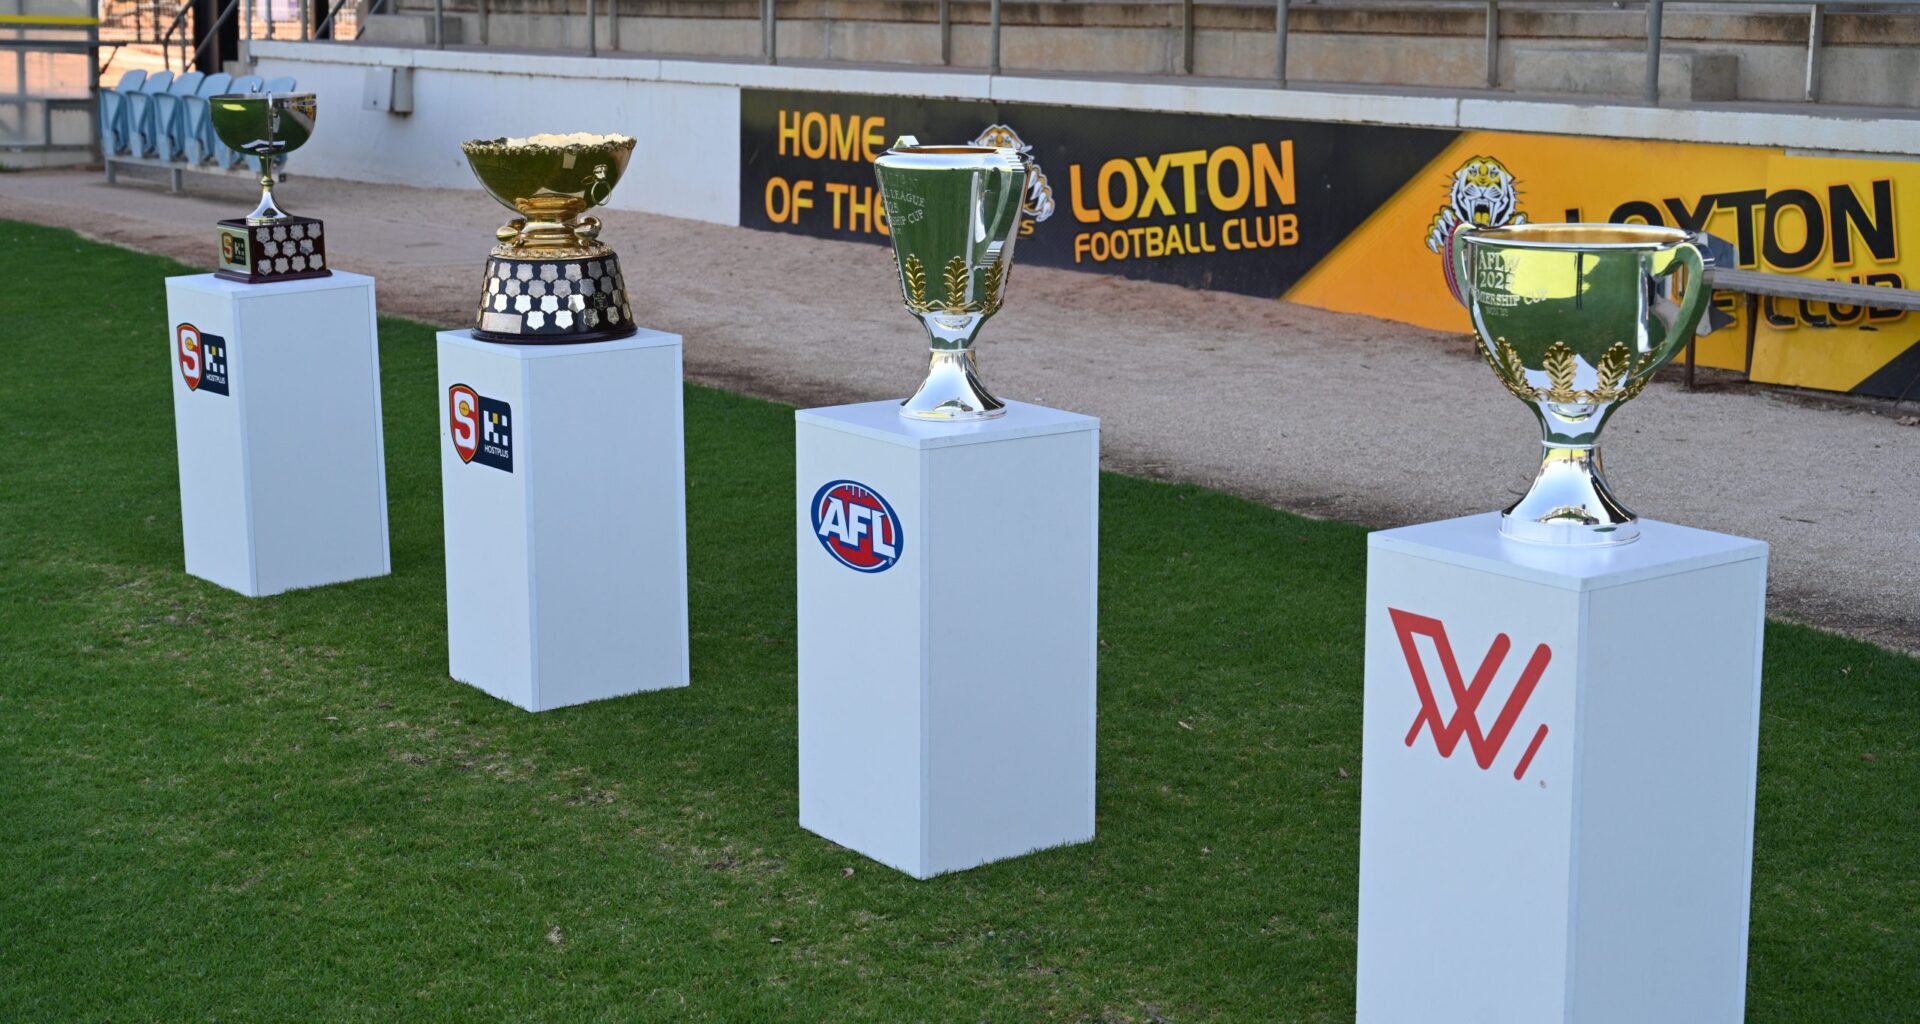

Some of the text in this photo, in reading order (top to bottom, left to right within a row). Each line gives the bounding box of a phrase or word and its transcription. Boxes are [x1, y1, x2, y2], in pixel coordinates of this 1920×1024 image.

[778, 109, 885, 164] HOME
[765, 176, 814, 225] OF
[1070, 139, 1296, 223] LOXTON
[907, 208, 924, 224] CUP
[1074, 221, 1217, 264] FOOTBALL
[1222, 213, 1299, 251] CLUB
[1563, 178, 1898, 270] XTON
[484, 444, 509, 459] HOSTPLUS
[818, 496, 896, 559] AFL
